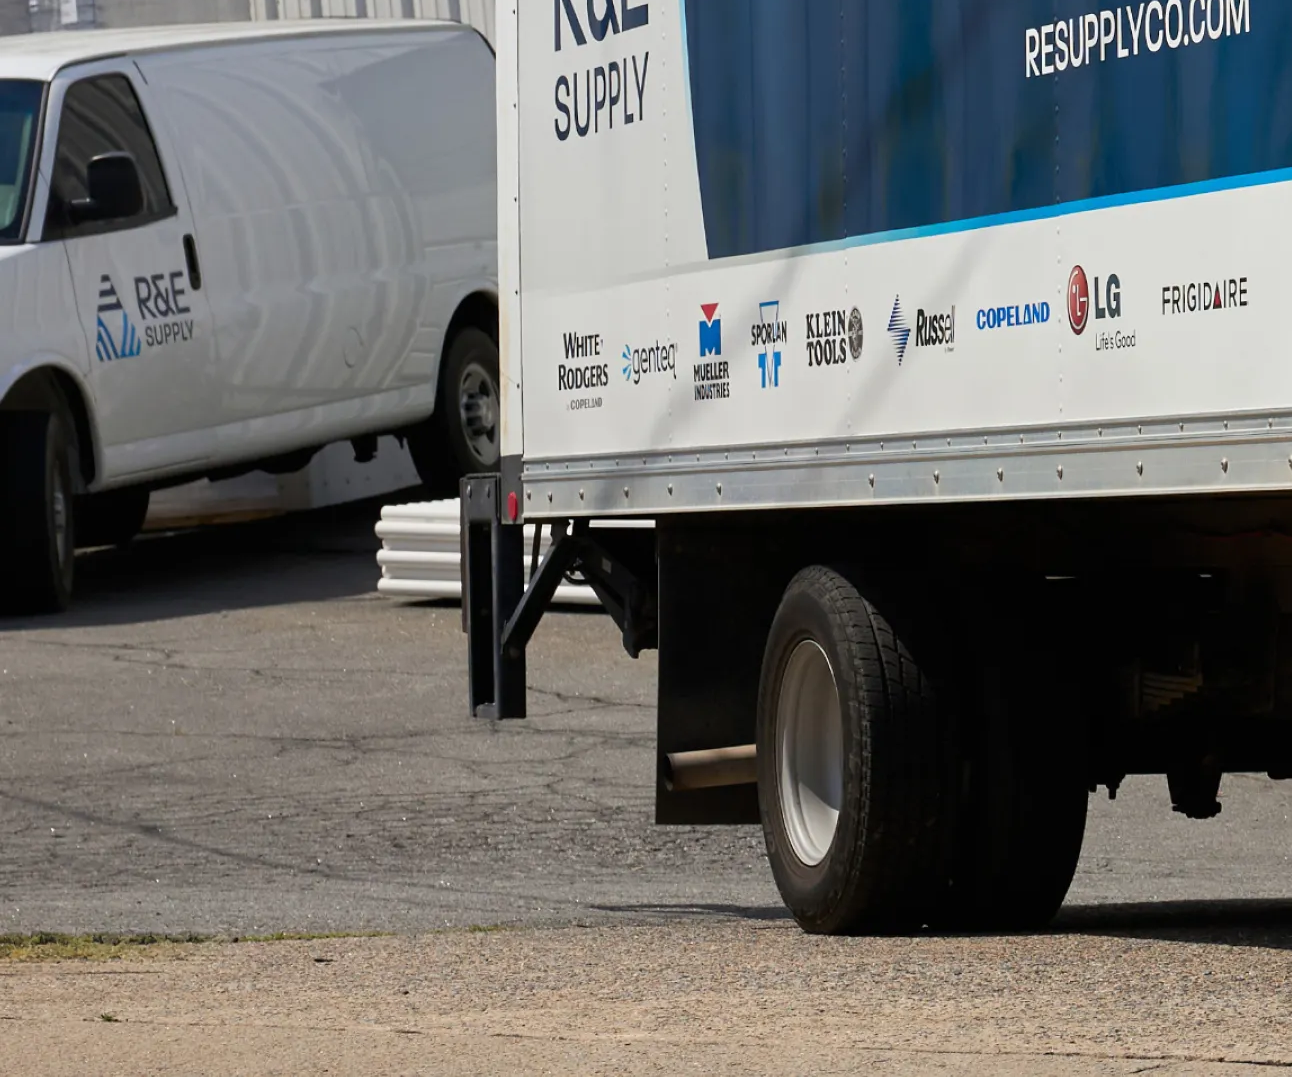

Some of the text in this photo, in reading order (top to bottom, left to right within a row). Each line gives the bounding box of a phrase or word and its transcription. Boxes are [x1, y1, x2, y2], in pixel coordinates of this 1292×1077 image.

[554, 51, 650, 142] SUPPLY
[133, 270, 191, 321] R&E
[1094, 273, 1121, 320] LG
[1161, 277, 1249, 316] FRIGIDAIRE
[805, 310, 846, 339] KLEIN
[976, 301, 1051, 330] COPELAND
[145, 319, 194, 347] SUPPLY
[751, 321, 788, 346] SPORLAN
[1115, 330, 1136, 349] Good
[632, 340, 677, 385] genteq
[806, 337, 847, 367] TOOLS
[693, 361, 730, 383] MUELLER
[694, 381, 730, 401] INDUSTRIES
